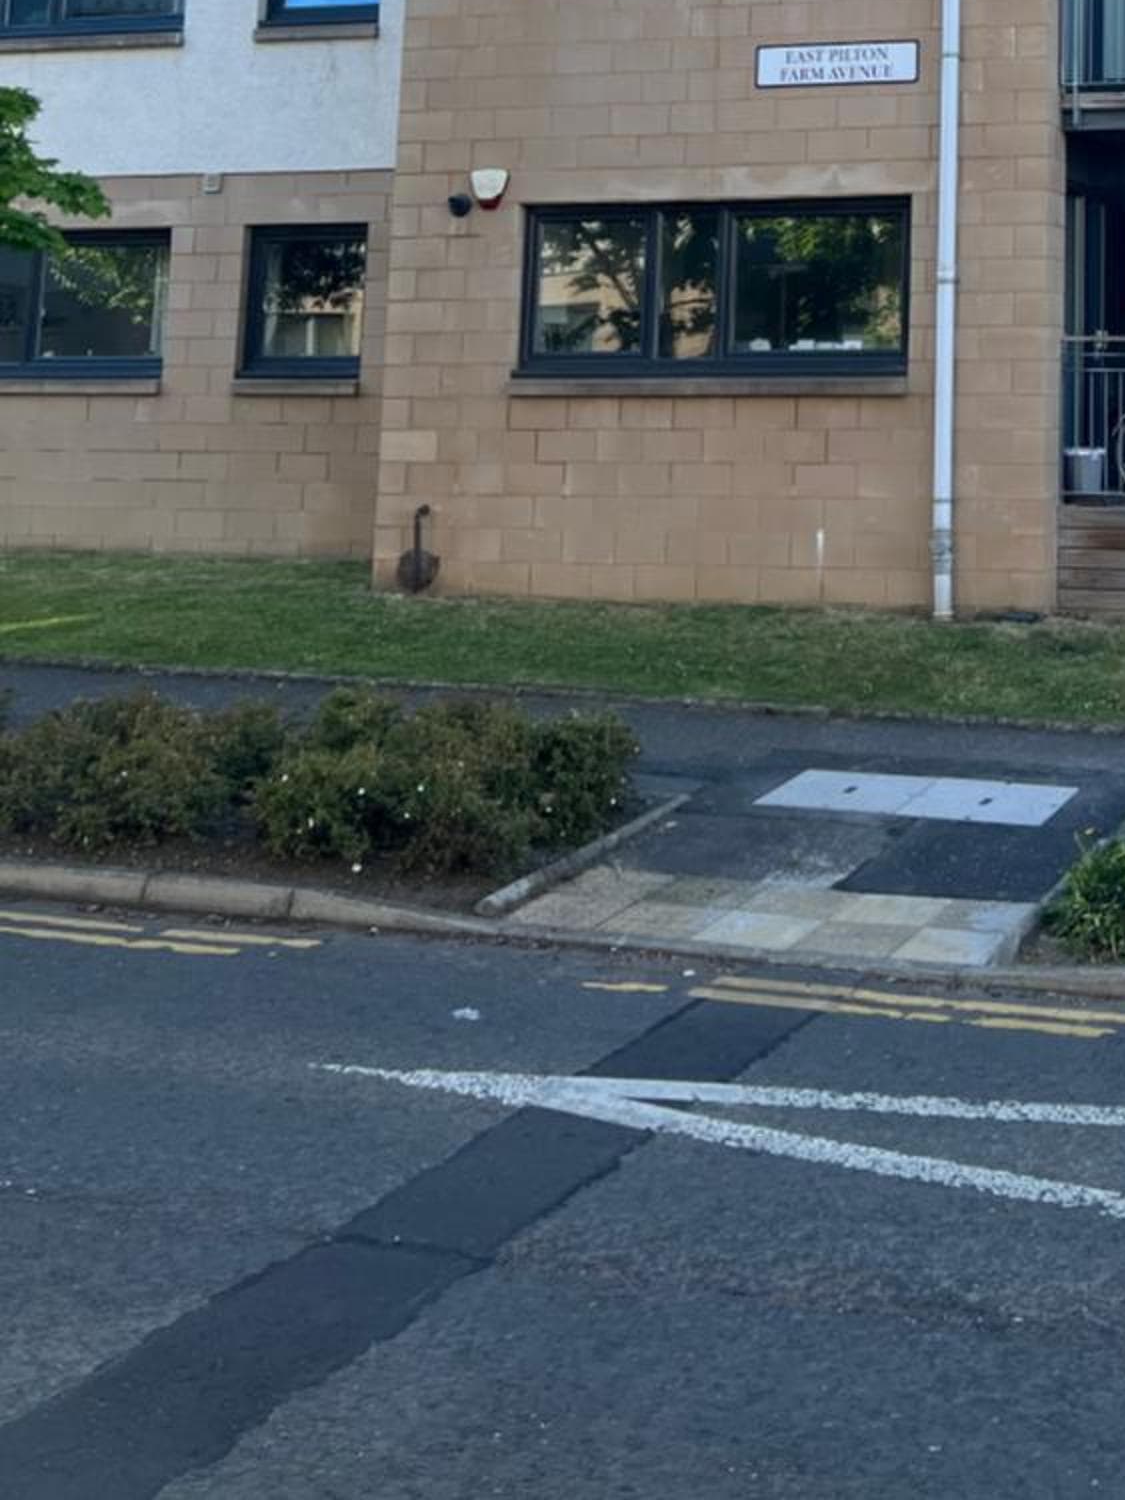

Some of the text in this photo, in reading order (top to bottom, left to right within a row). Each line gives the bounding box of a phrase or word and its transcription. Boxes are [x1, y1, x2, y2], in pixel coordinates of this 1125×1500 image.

[785, 47, 888, 64] EAST PILTON
[780, 65, 893, 82] FARM AVENUE
